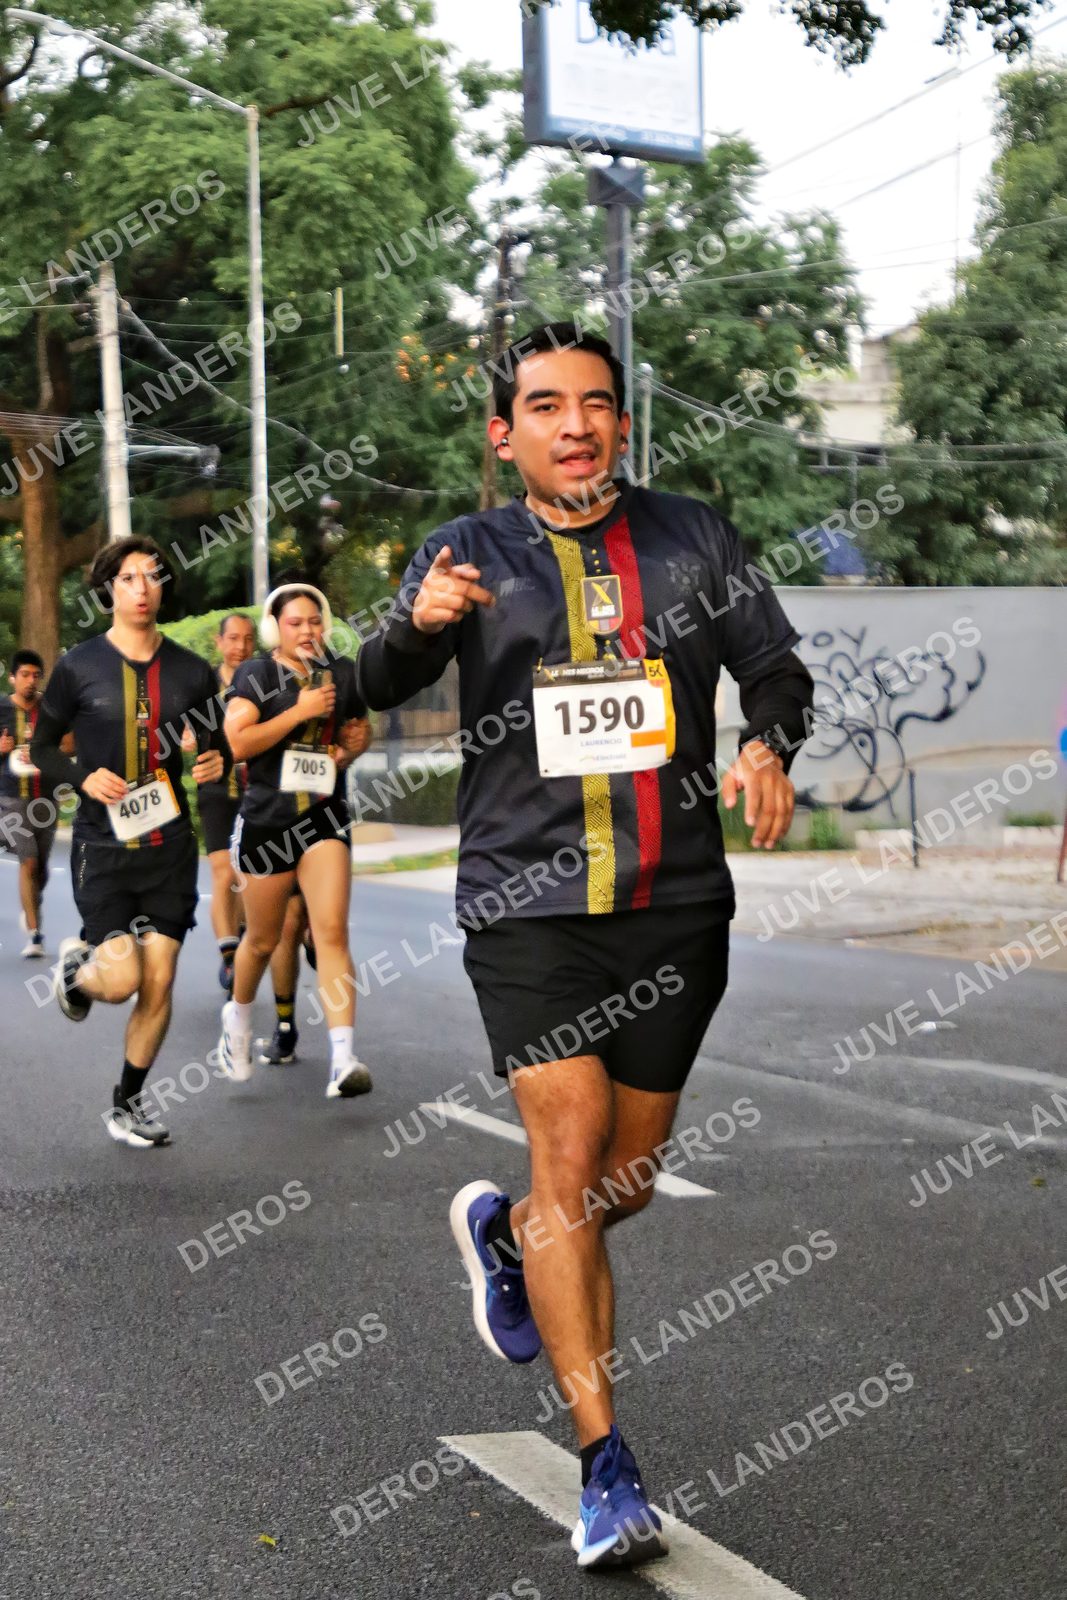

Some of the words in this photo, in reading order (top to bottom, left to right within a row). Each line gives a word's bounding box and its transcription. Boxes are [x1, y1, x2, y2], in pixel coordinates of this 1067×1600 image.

[554, 695, 645, 736] 1590
[292, 757, 327, 777] 7005
[119, 788, 162, 818] 4078
